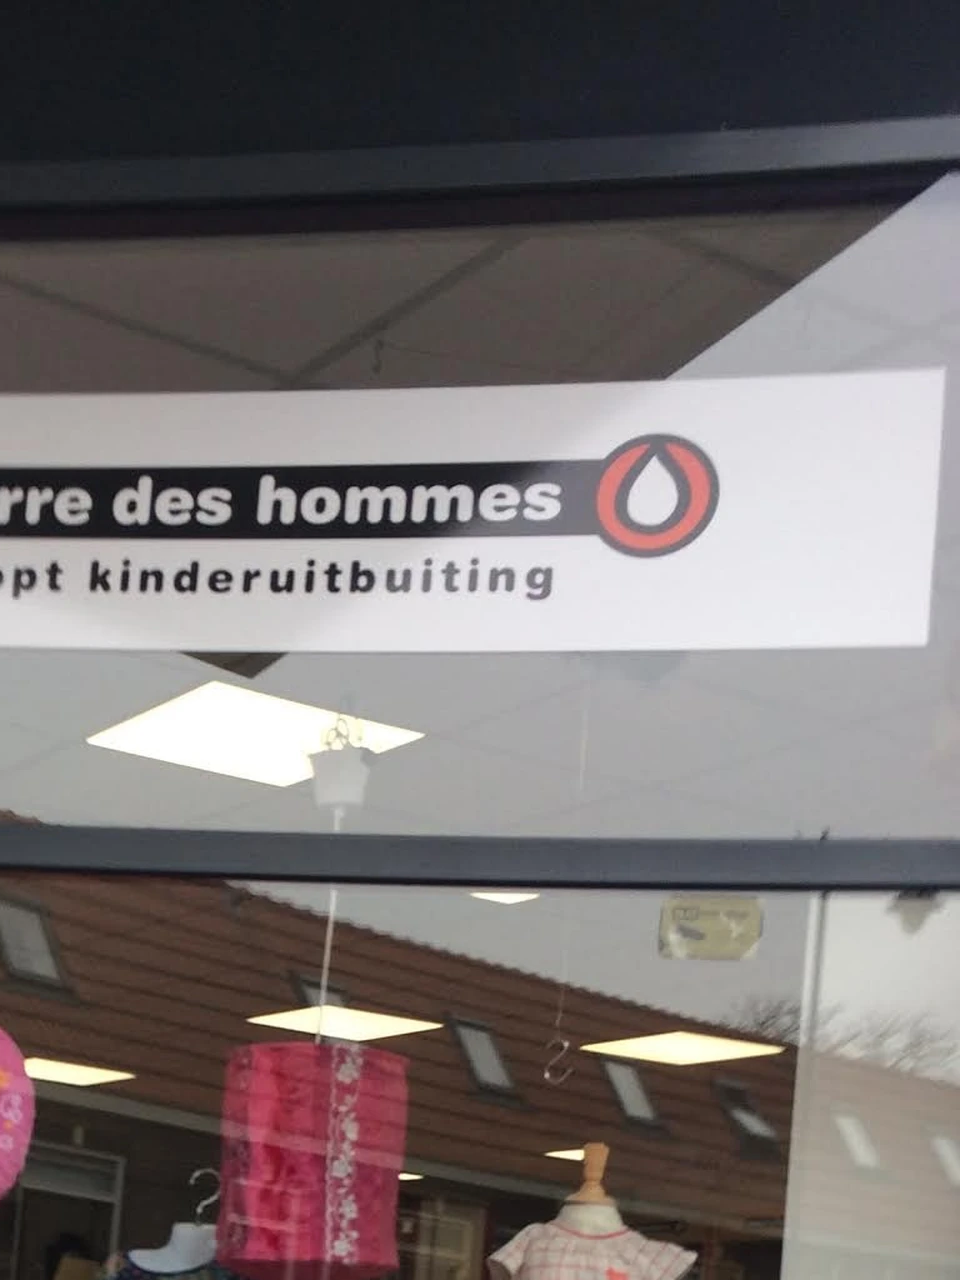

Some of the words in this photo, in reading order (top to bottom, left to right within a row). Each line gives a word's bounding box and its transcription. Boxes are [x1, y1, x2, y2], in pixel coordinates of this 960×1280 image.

[113, 476, 233, 525] des
[257, 475, 563, 525] hommes
[88, 556, 555, 602] kinderuitbuiting
